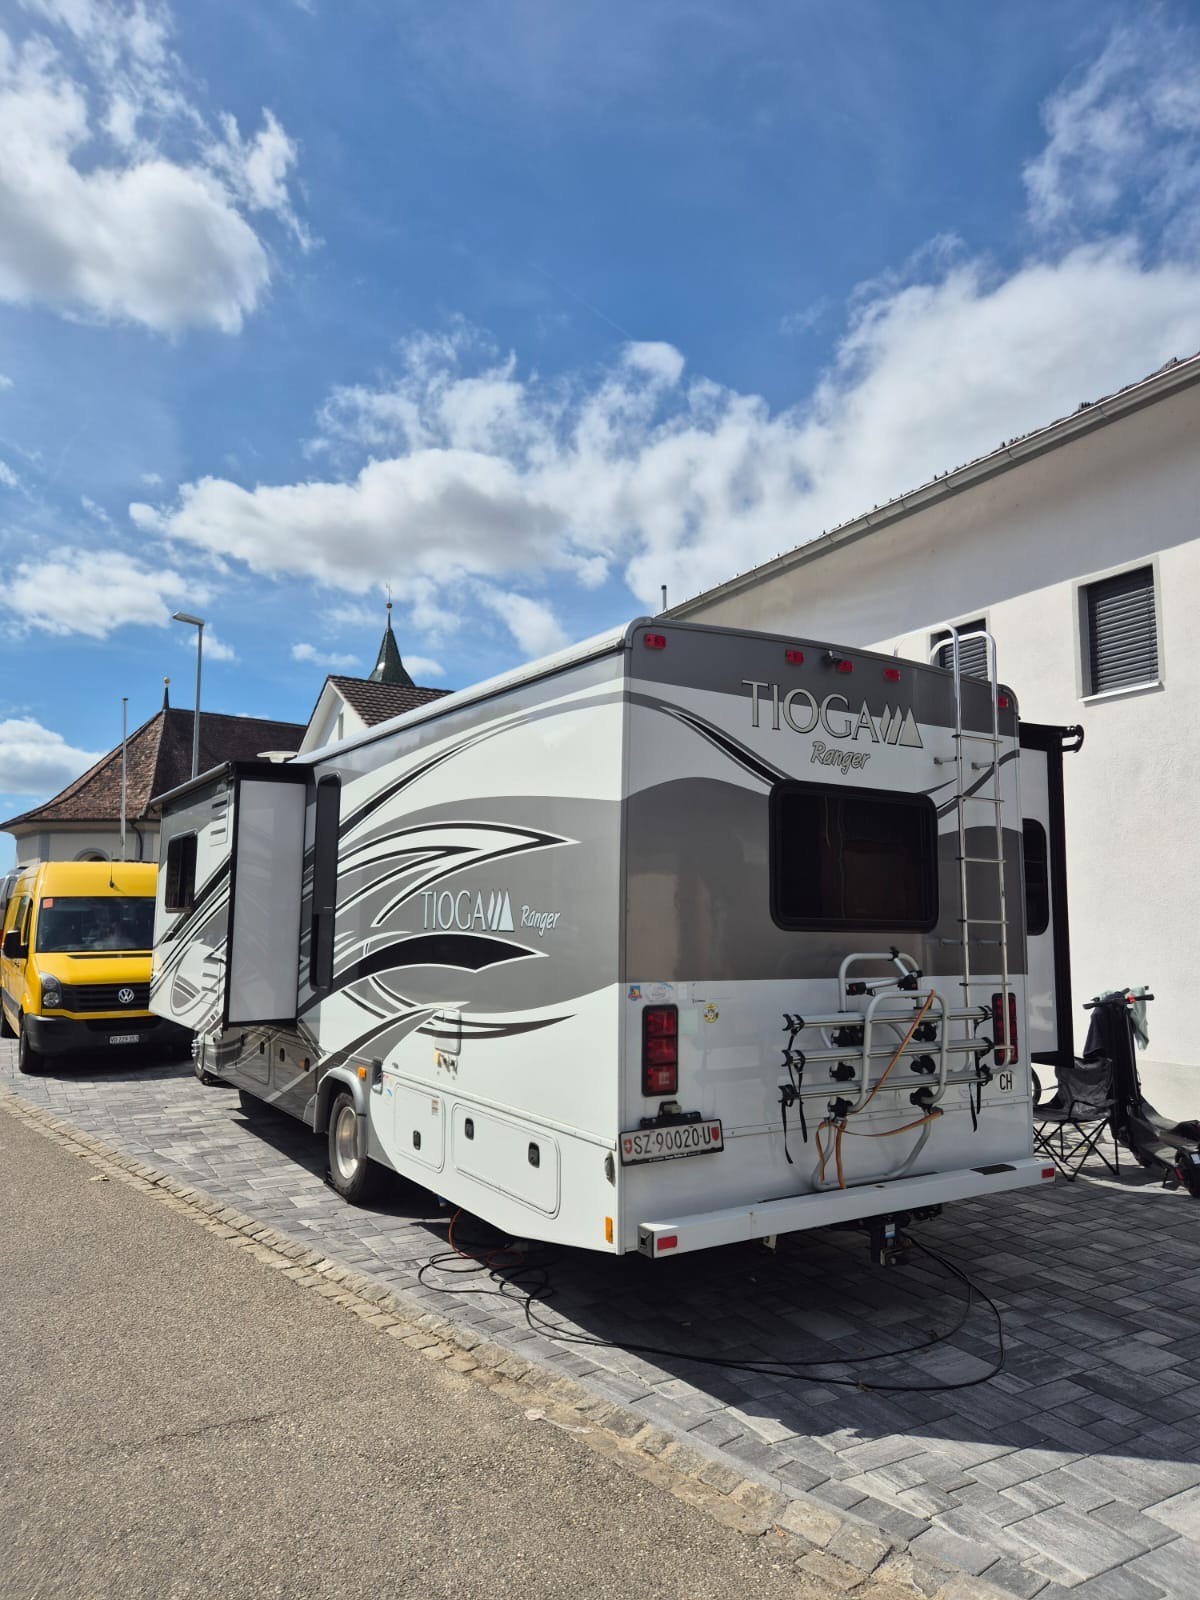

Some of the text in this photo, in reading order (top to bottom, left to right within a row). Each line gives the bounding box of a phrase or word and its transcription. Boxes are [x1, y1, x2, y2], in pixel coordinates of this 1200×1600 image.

[741, 679, 880, 743] TIOGA
[810, 740, 871, 775] Ranger
[421, 889, 561, 937] TIOGA Ranger
[999, 1073, 1013, 1090] CH
